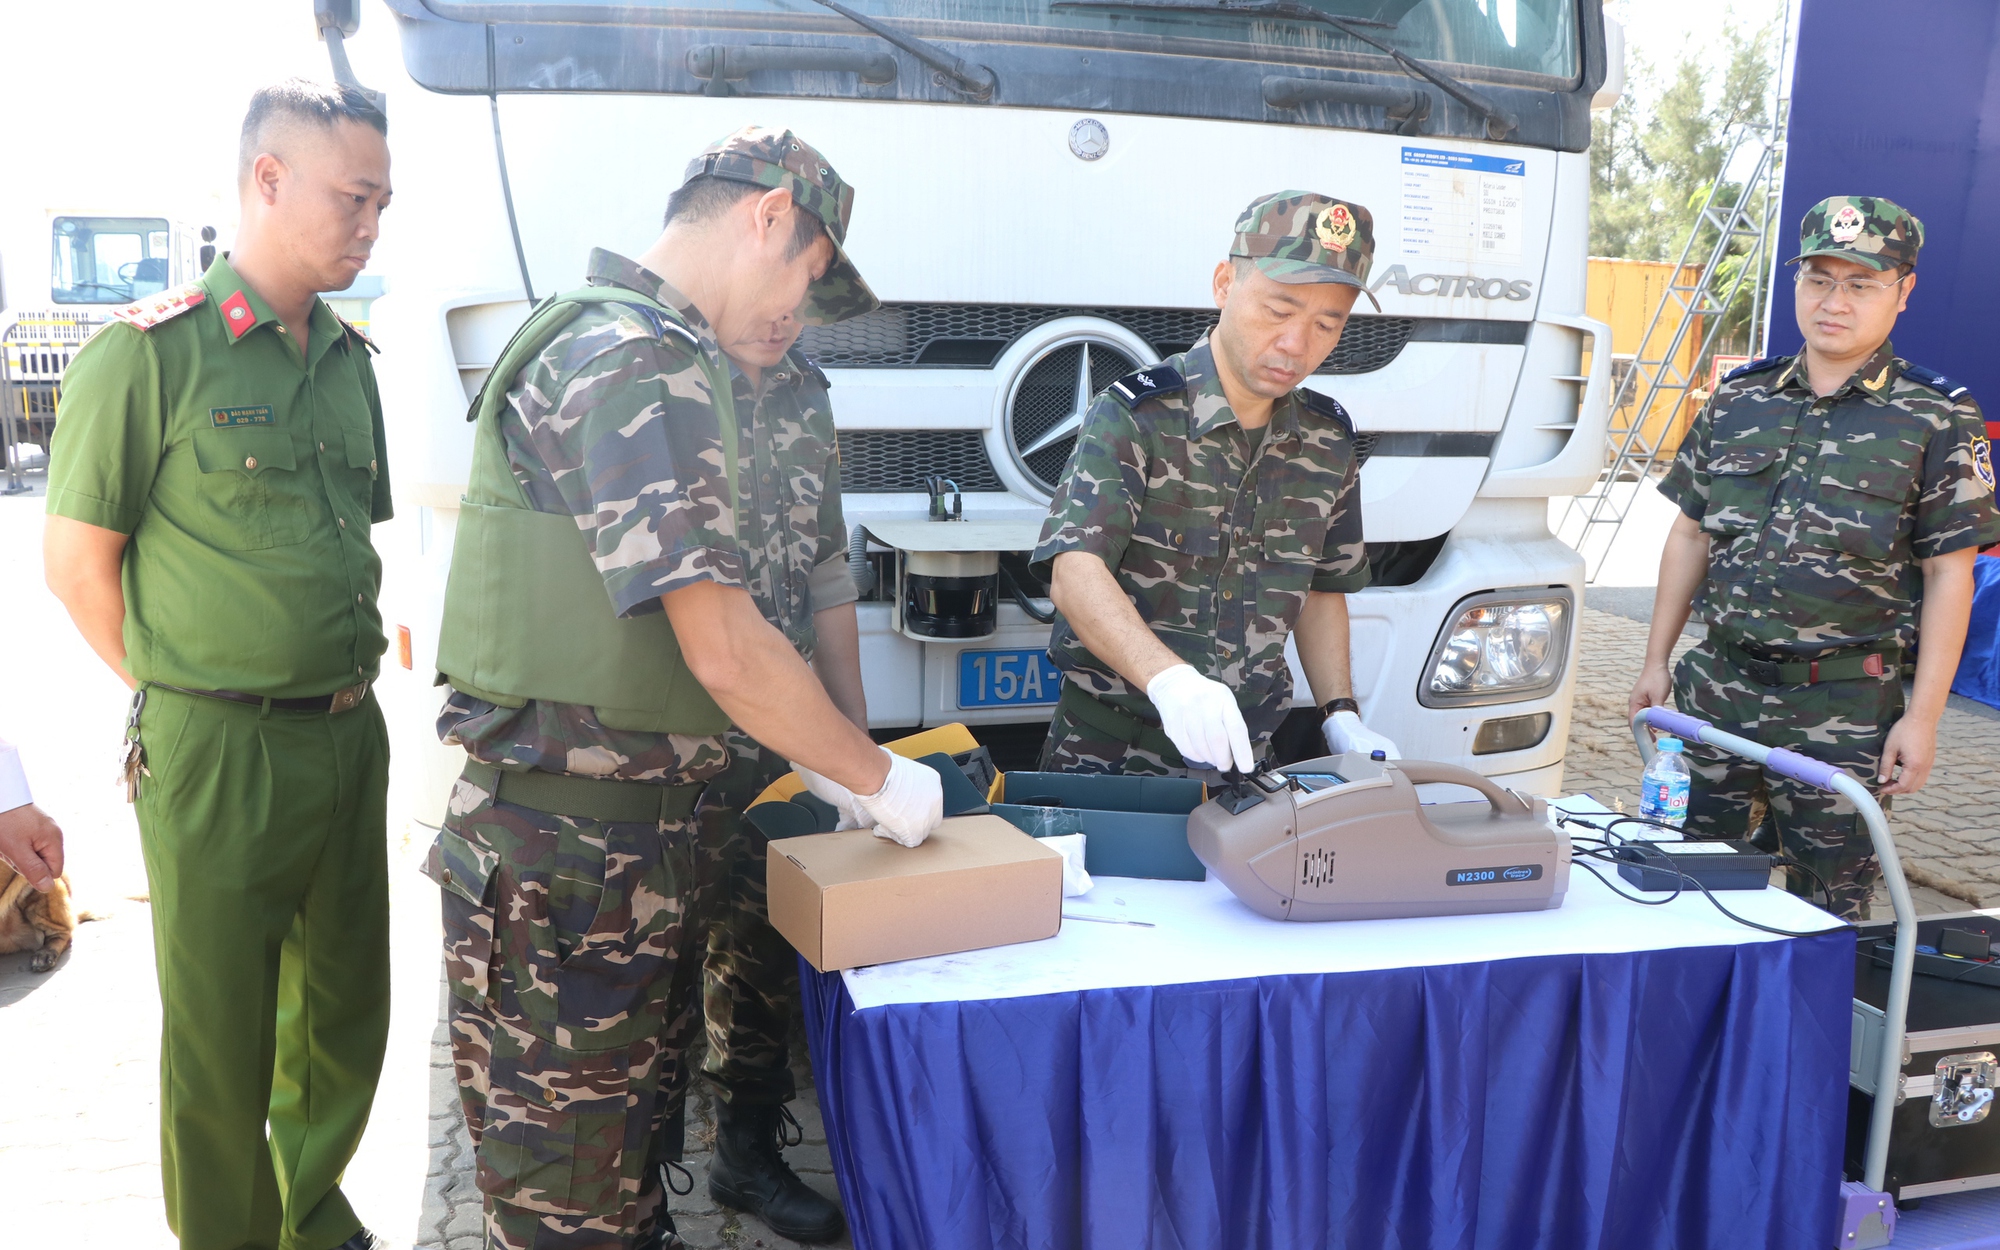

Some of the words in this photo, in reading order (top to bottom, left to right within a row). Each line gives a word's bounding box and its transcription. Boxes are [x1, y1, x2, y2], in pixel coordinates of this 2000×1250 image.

[1498, 200, 1517, 208] 11200
[1370, 264, 1533, 302] ACTROS
[1457, 870, 1495, 882] N2300
